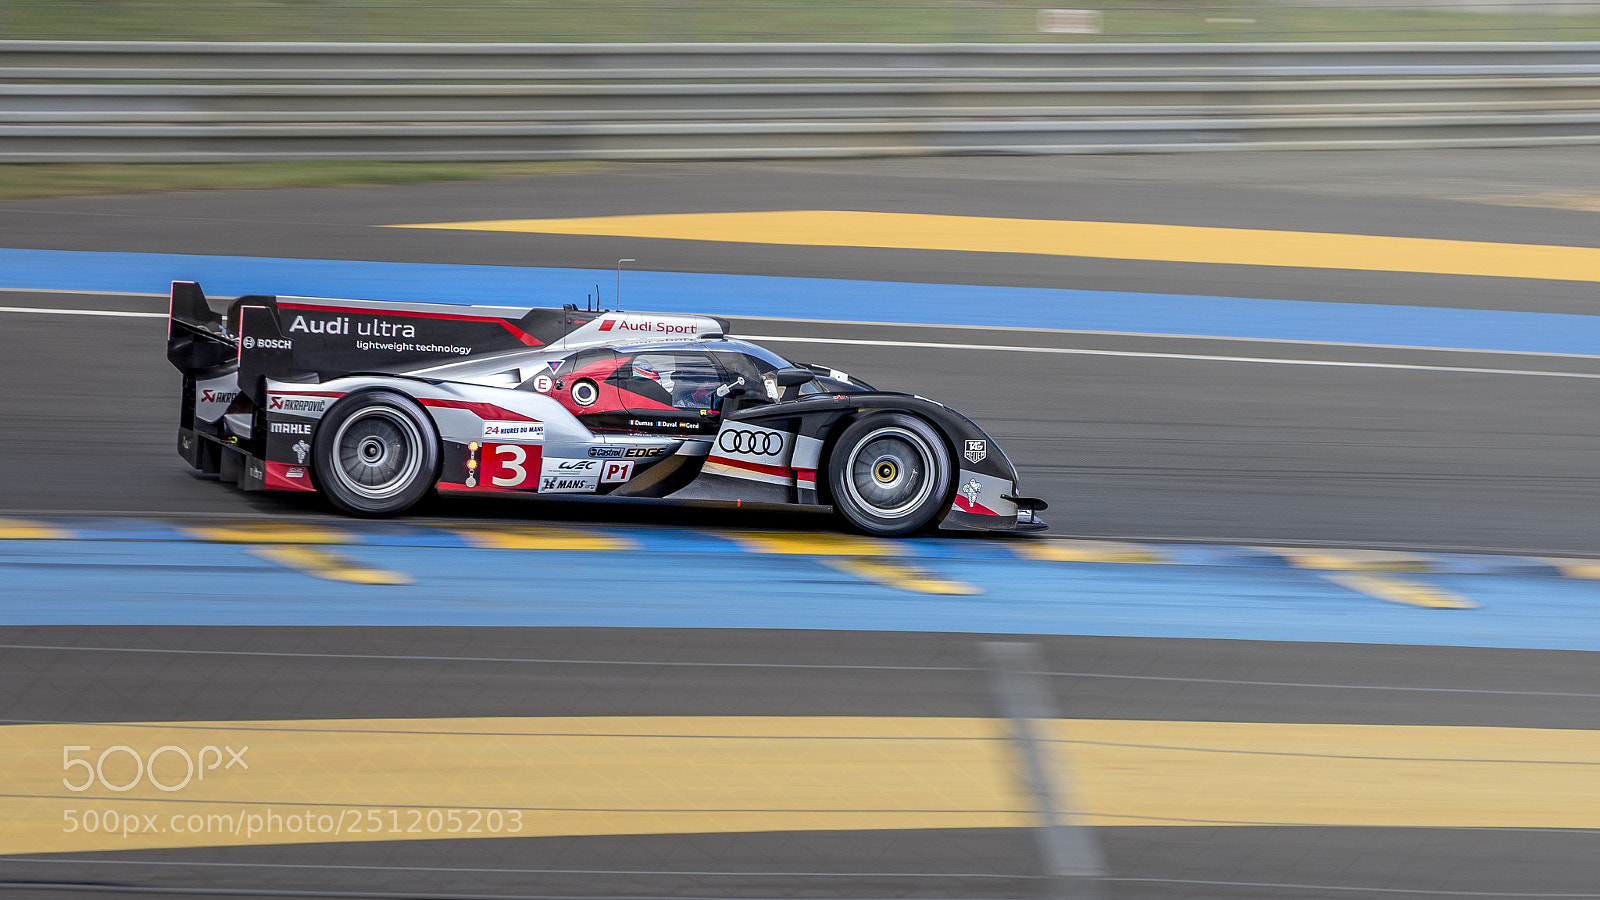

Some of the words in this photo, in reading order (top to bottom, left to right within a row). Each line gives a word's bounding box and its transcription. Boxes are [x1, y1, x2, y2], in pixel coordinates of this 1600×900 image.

[289, 315, 349, 335] Audi
[357, 319, 415, 338] ultra
[619, 321, 652, 331] Audi
[657, 322, 697, 334] Sport
[257, 339, 292, 349] BOSCH
[356, 340, 414, 352] lightweight
[416, 343, 472, 355] technology
[538, 378, 548, 389] E
[283, 399, 326, 412] AKRAPOVIČ
[270, 422, 312, 435] MAHLE
[485, 426, 500, 434] 24
[968, 441, 984, 451] TAG
[597, 448, 622, 457] Castrol
[624, 448, 667, 457] EDGE
[492, 444, 527, 487] 3
[558, 460, 597, 470] WEC
[606, 464, 630, 480] P1
[557, 479, 585, 489] MANS
